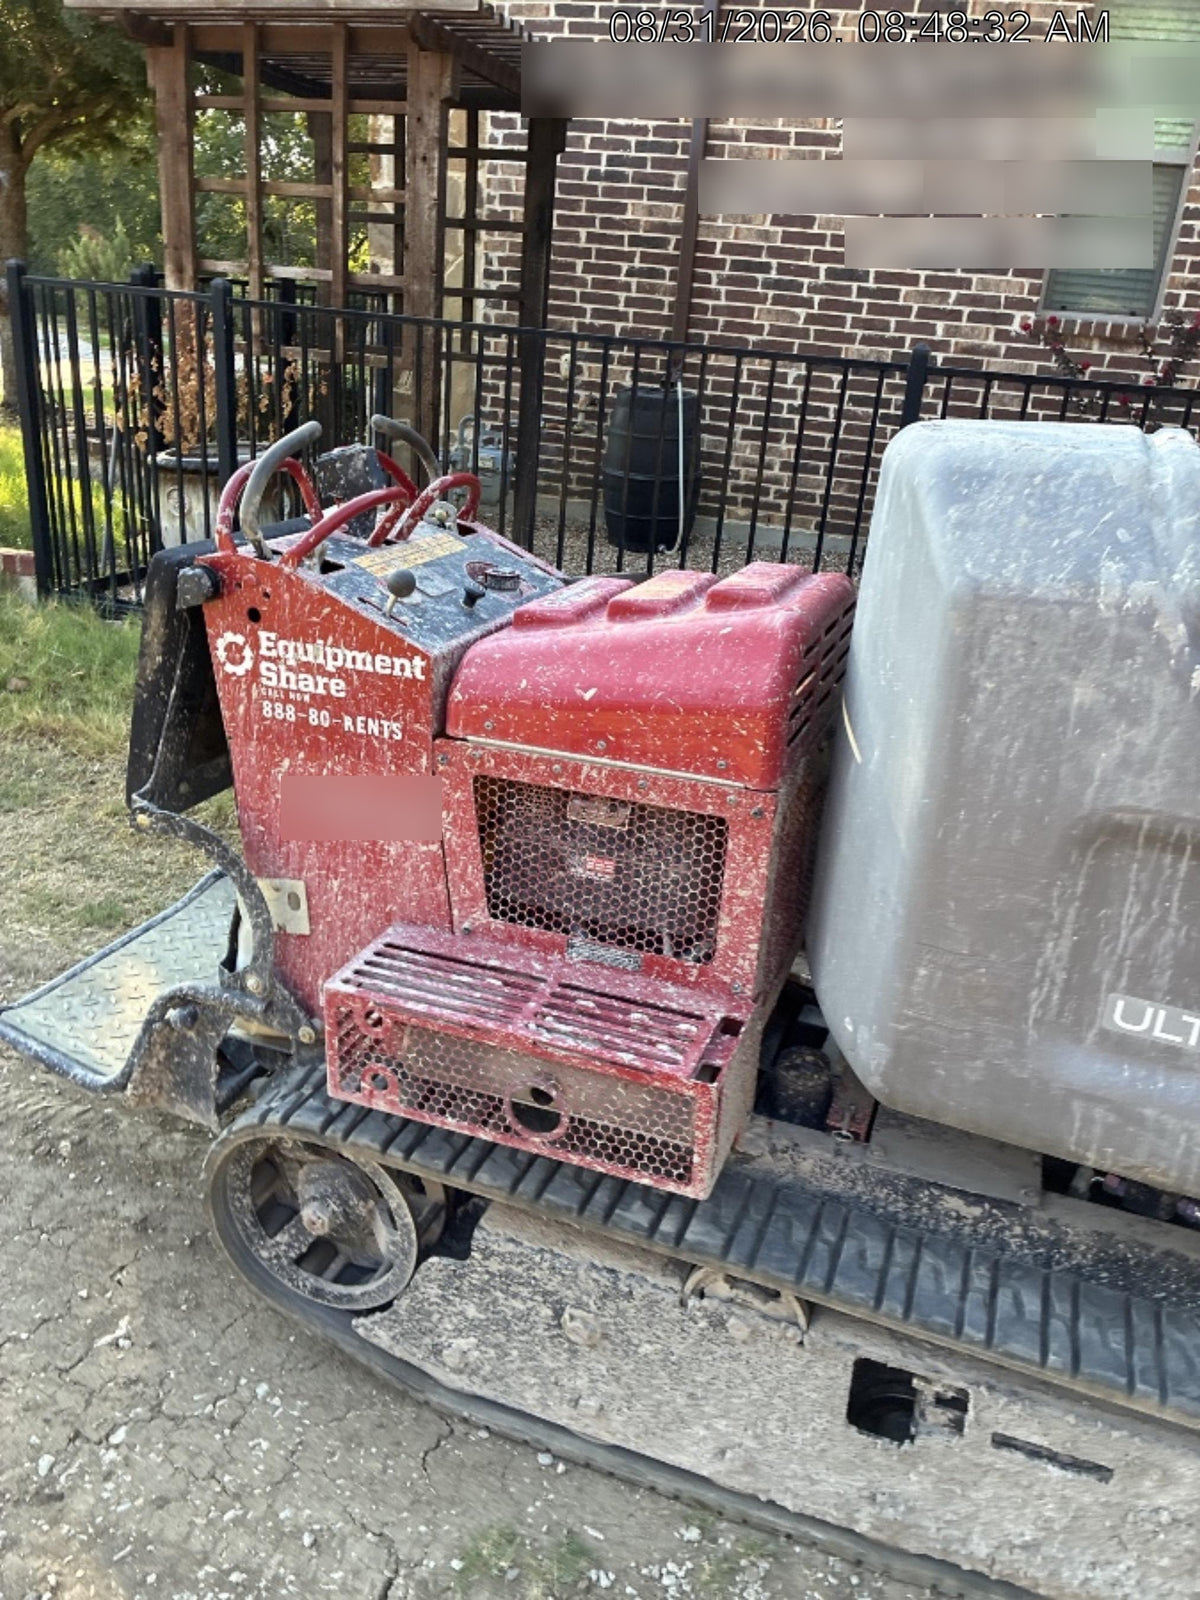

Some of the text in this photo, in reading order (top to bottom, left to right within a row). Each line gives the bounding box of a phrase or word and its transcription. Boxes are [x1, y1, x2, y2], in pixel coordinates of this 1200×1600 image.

[258, 630, 426, 681] Equipment
[259, 661, 346, 698] Share
[262, 700, 403, 740] 888-80-RENTS
